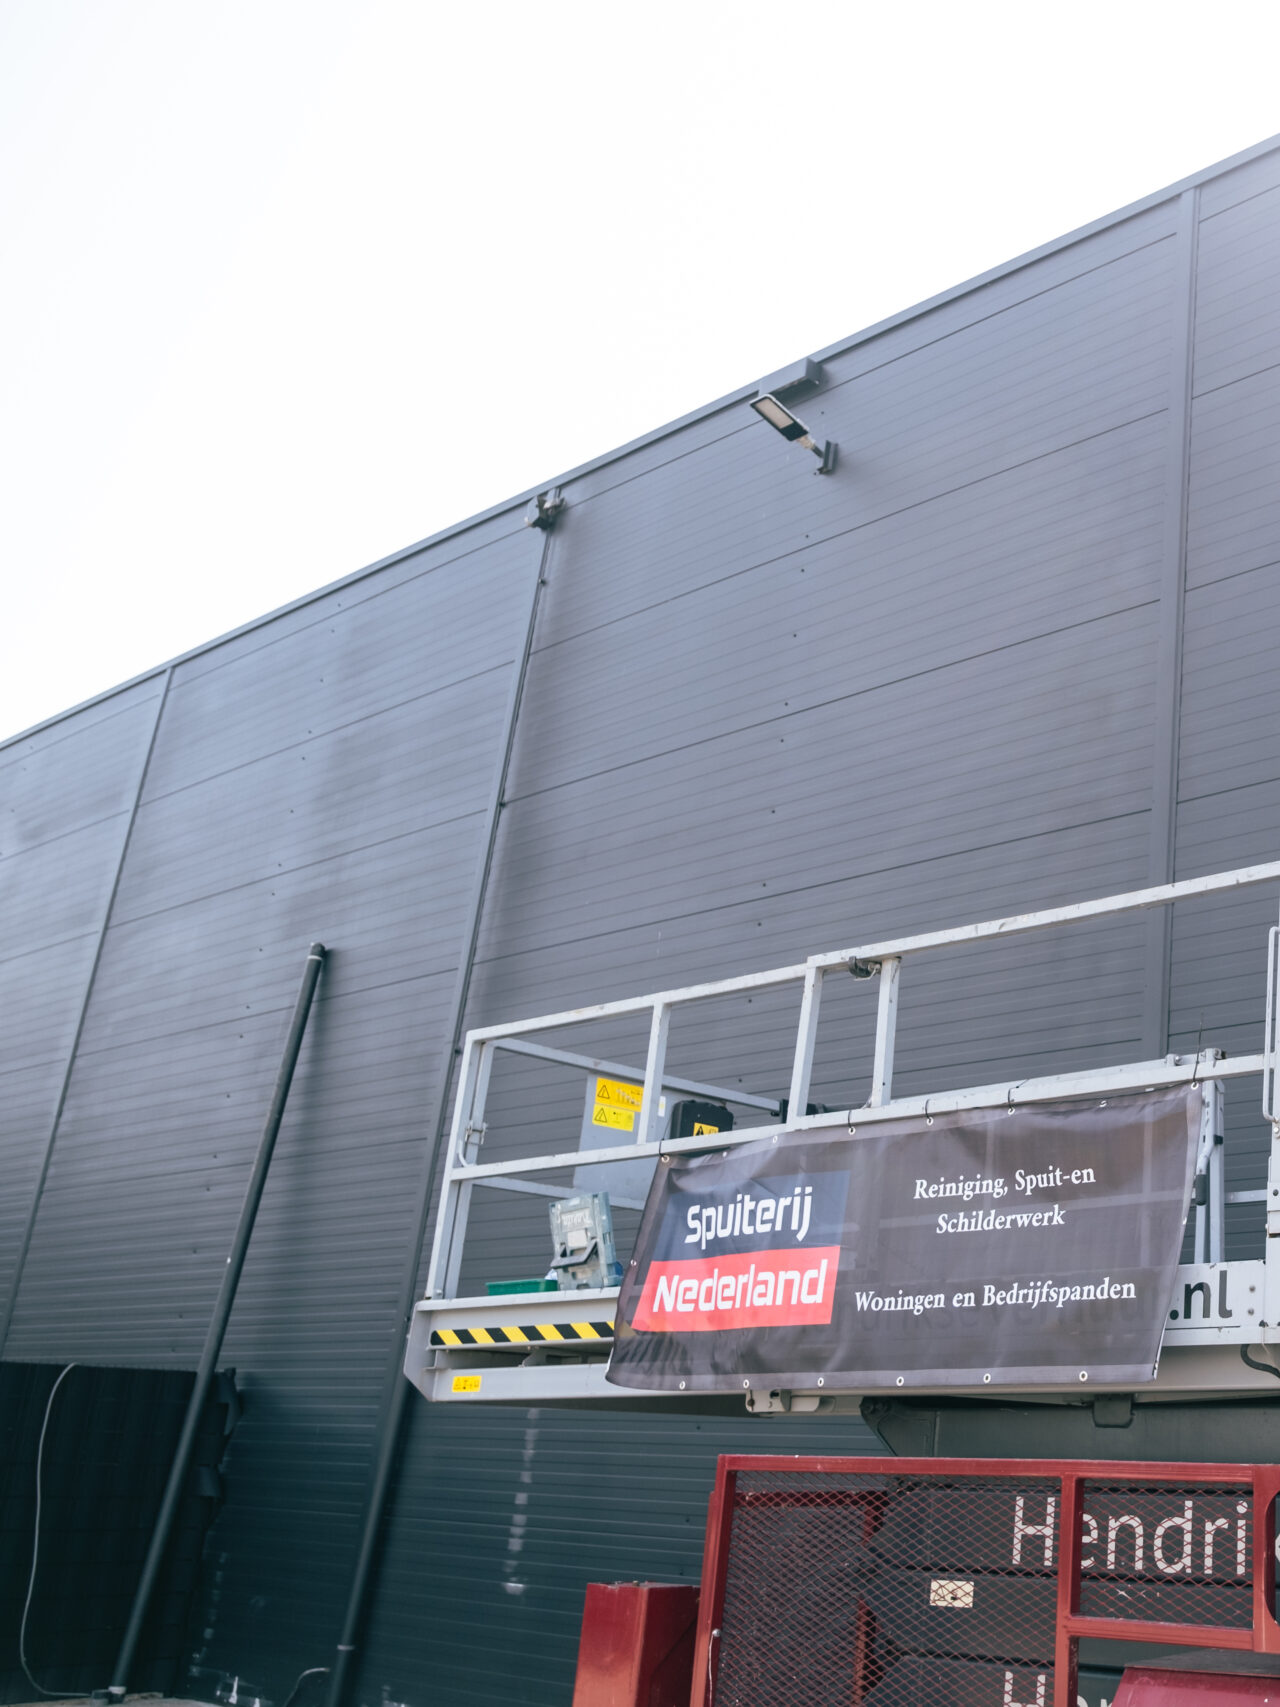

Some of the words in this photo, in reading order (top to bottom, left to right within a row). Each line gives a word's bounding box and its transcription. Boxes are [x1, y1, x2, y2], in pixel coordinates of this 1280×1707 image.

[913, 1174, 1008, 1201] Reiniging,
[1015, 1165, 1096, 1196] Spuit-en
[684, 1186, 813, 1250] Spuiterij
[936, 1204, 1066, 1234] Schilderwerk
[652, 1259, 828, 1313] Nederland
[855, 1289, 945, 1315] Woningen
[952, 1291, 976, 1307] en
[982, 1277, 1137, 1309] Bedrijfspanden
